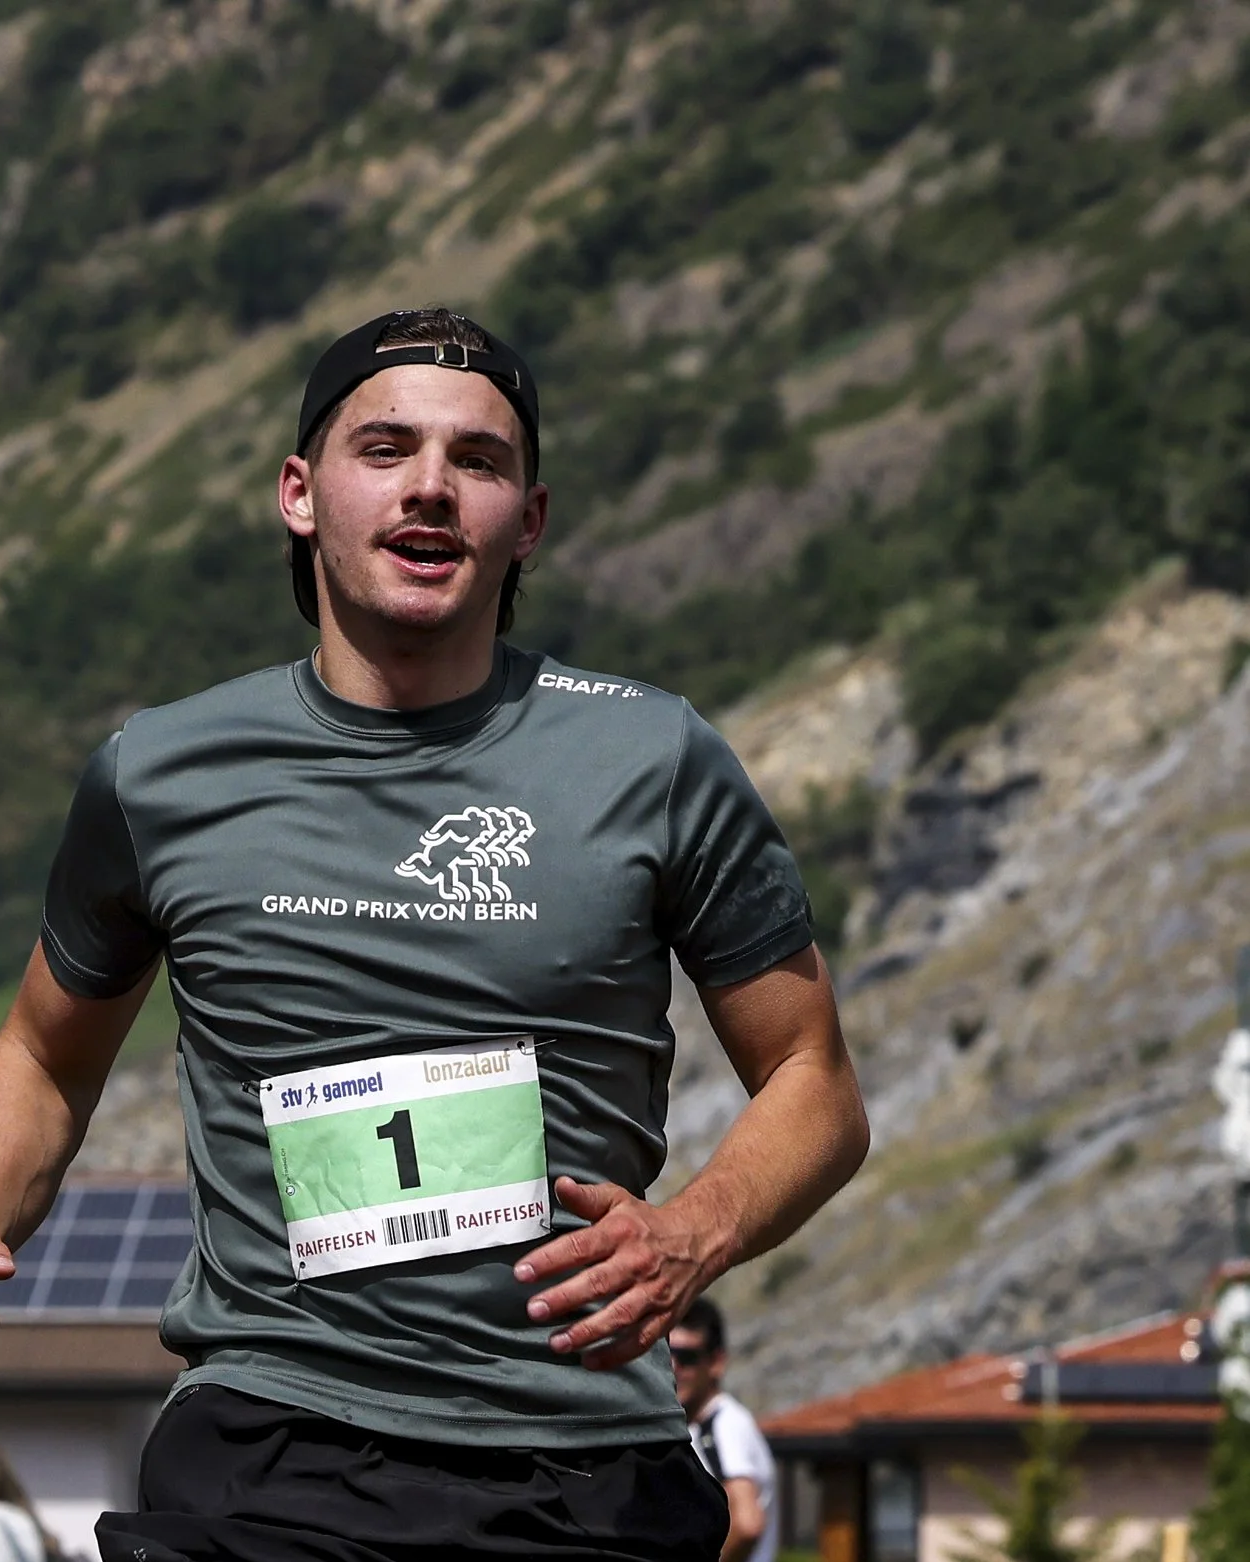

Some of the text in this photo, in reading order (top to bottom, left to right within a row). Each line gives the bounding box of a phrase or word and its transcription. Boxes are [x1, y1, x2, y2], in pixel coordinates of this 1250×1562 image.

[537, 673, 622, 696] CRAFT
[261, 894, 538, 921] GRAND PRIX VON BERN
[423, 1047, 512, 1083] lonzalauf
[280, 1071, 384, 1109] stv gampel
[375, 1109, 422, 1190] 1
[456, 1201, 545, 1230] RAIFFEISEN
[296, 1229, 377, 1258] RAIFFEISEN
